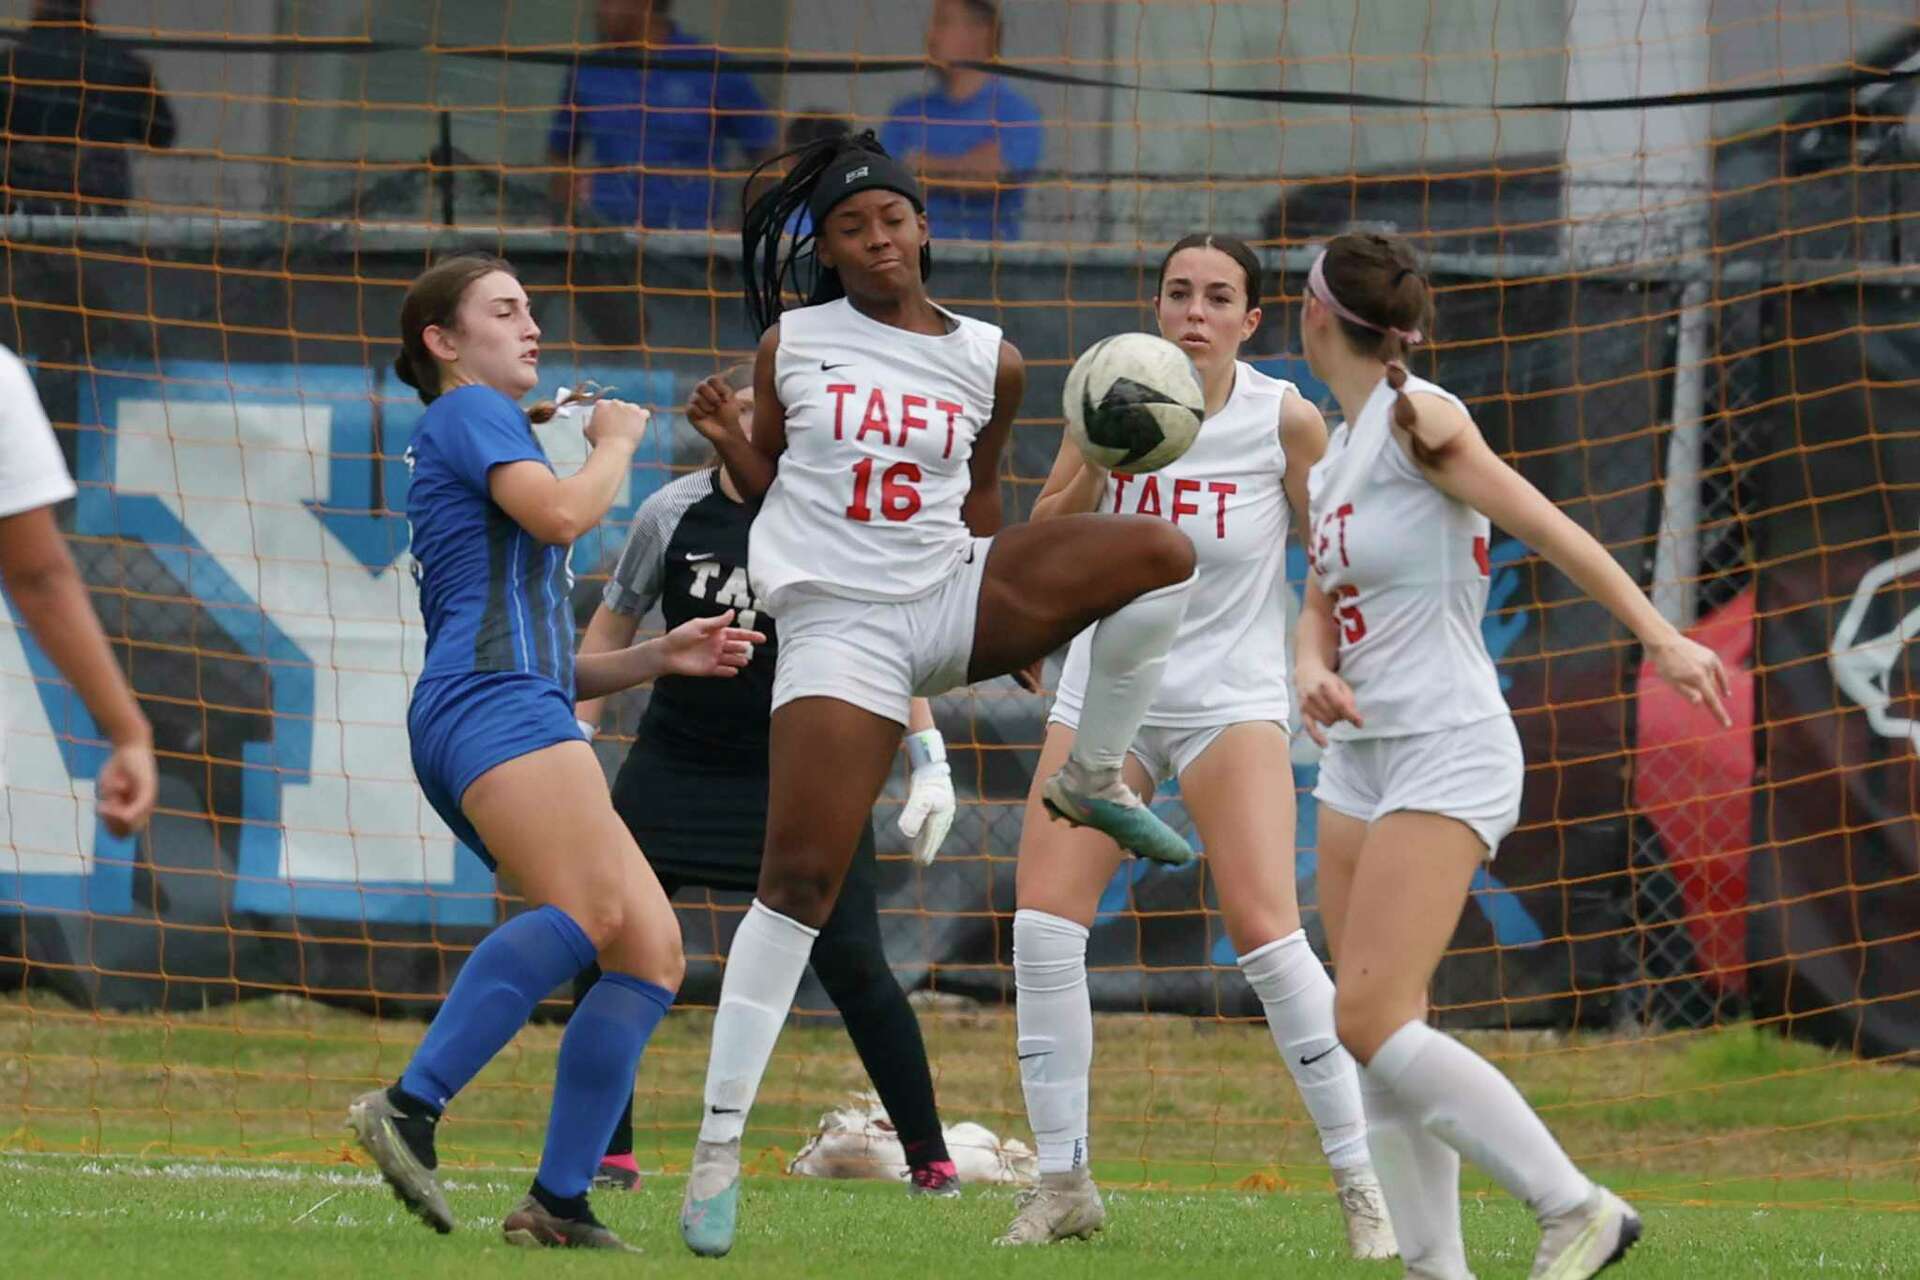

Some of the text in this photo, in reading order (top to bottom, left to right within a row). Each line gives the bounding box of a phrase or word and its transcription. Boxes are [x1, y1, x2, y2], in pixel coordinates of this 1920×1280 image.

[826, 384, 963, 459] TAFT
[845, 457, 922, 522] 16
[1109, 470, 1237, 539] TAFT
[688, 561, 768, 614] TA
